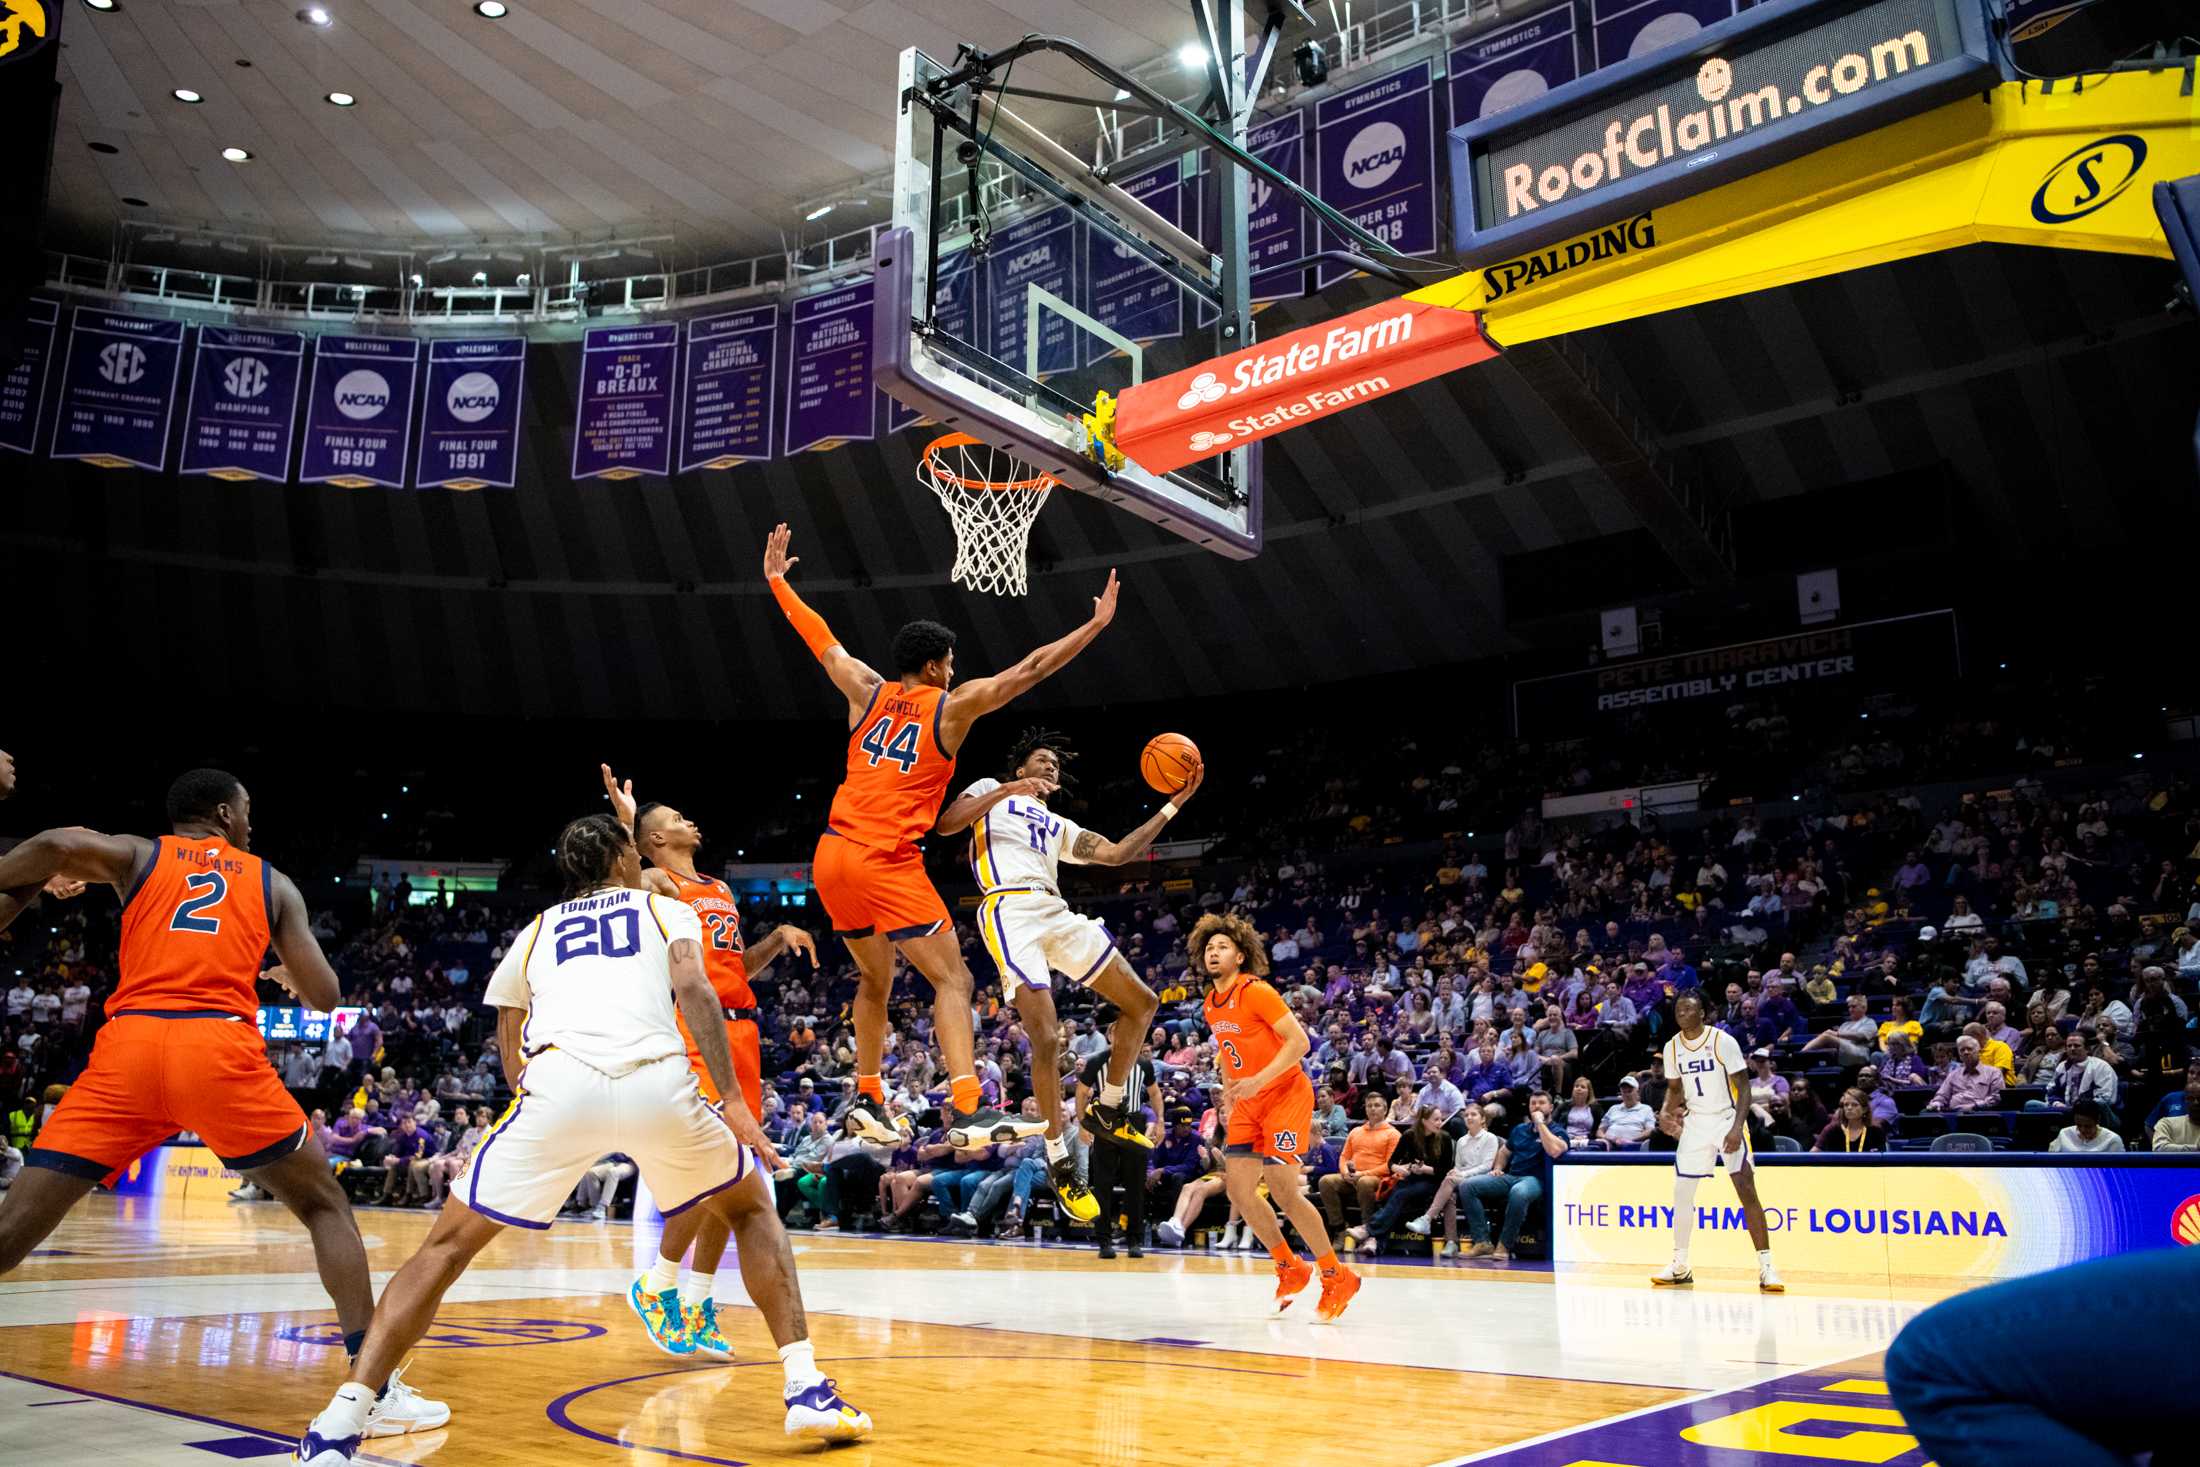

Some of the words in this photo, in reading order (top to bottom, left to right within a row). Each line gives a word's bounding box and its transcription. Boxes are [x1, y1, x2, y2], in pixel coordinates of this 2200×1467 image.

[1503, 30, 1929, 217] RoofClaim.com
[1350, 145, 1403, 178] NCAA
[1351, 209, 1383, 228] UPER
[1387, 201, 1408, 219] SIX
[1008, 245, 1050, 276] NCAA
[1483, 210, 1656, 304] SPALDING
[99, 342, 146, 384] SEC
[223, 357, 269, 398] SEC
[340, 393, 388, 407] NCAA
[596, 376, 658, 395] BREAUX
[452, 396, 497, 410] NCAA
[325, 435, 355, 448] FINAL
[360, 438, 388, 450] FOUR
[332, 449, 377, 468] 1990
[439, 440, 468, 452] FINAL
[471, 439, 499, 451] FOUR
[449, 452, 487, 470] 1991
[1598, 673, 1737, 711] ASSEMBLY
[1745, 655, 1855, 689] CENTER
[1599, 656, 1673, 689] PETE
[860, 715, 922, 774] 44
[1008, 799, 1061, 838] LSU
[1027, 823, 1048, 857] 11
[169, 870, 229, 936] 2
[561, 890, 631, 915] FOUNTAIN
[554, 907, 641, 967] 20
[706, 912, 744, 953] 22
[1222, 1039, 1243, 1070] 3
[1679, 1059, 1715, 1075] LSU
[1694, 1076, 1704, 1097] 1
[1564, 1204, 1609, 1228] THE
[1618, 1205, 1748, 1233] RHYHM
[1810, 1209, 2008, 1239] LOUISIANA
